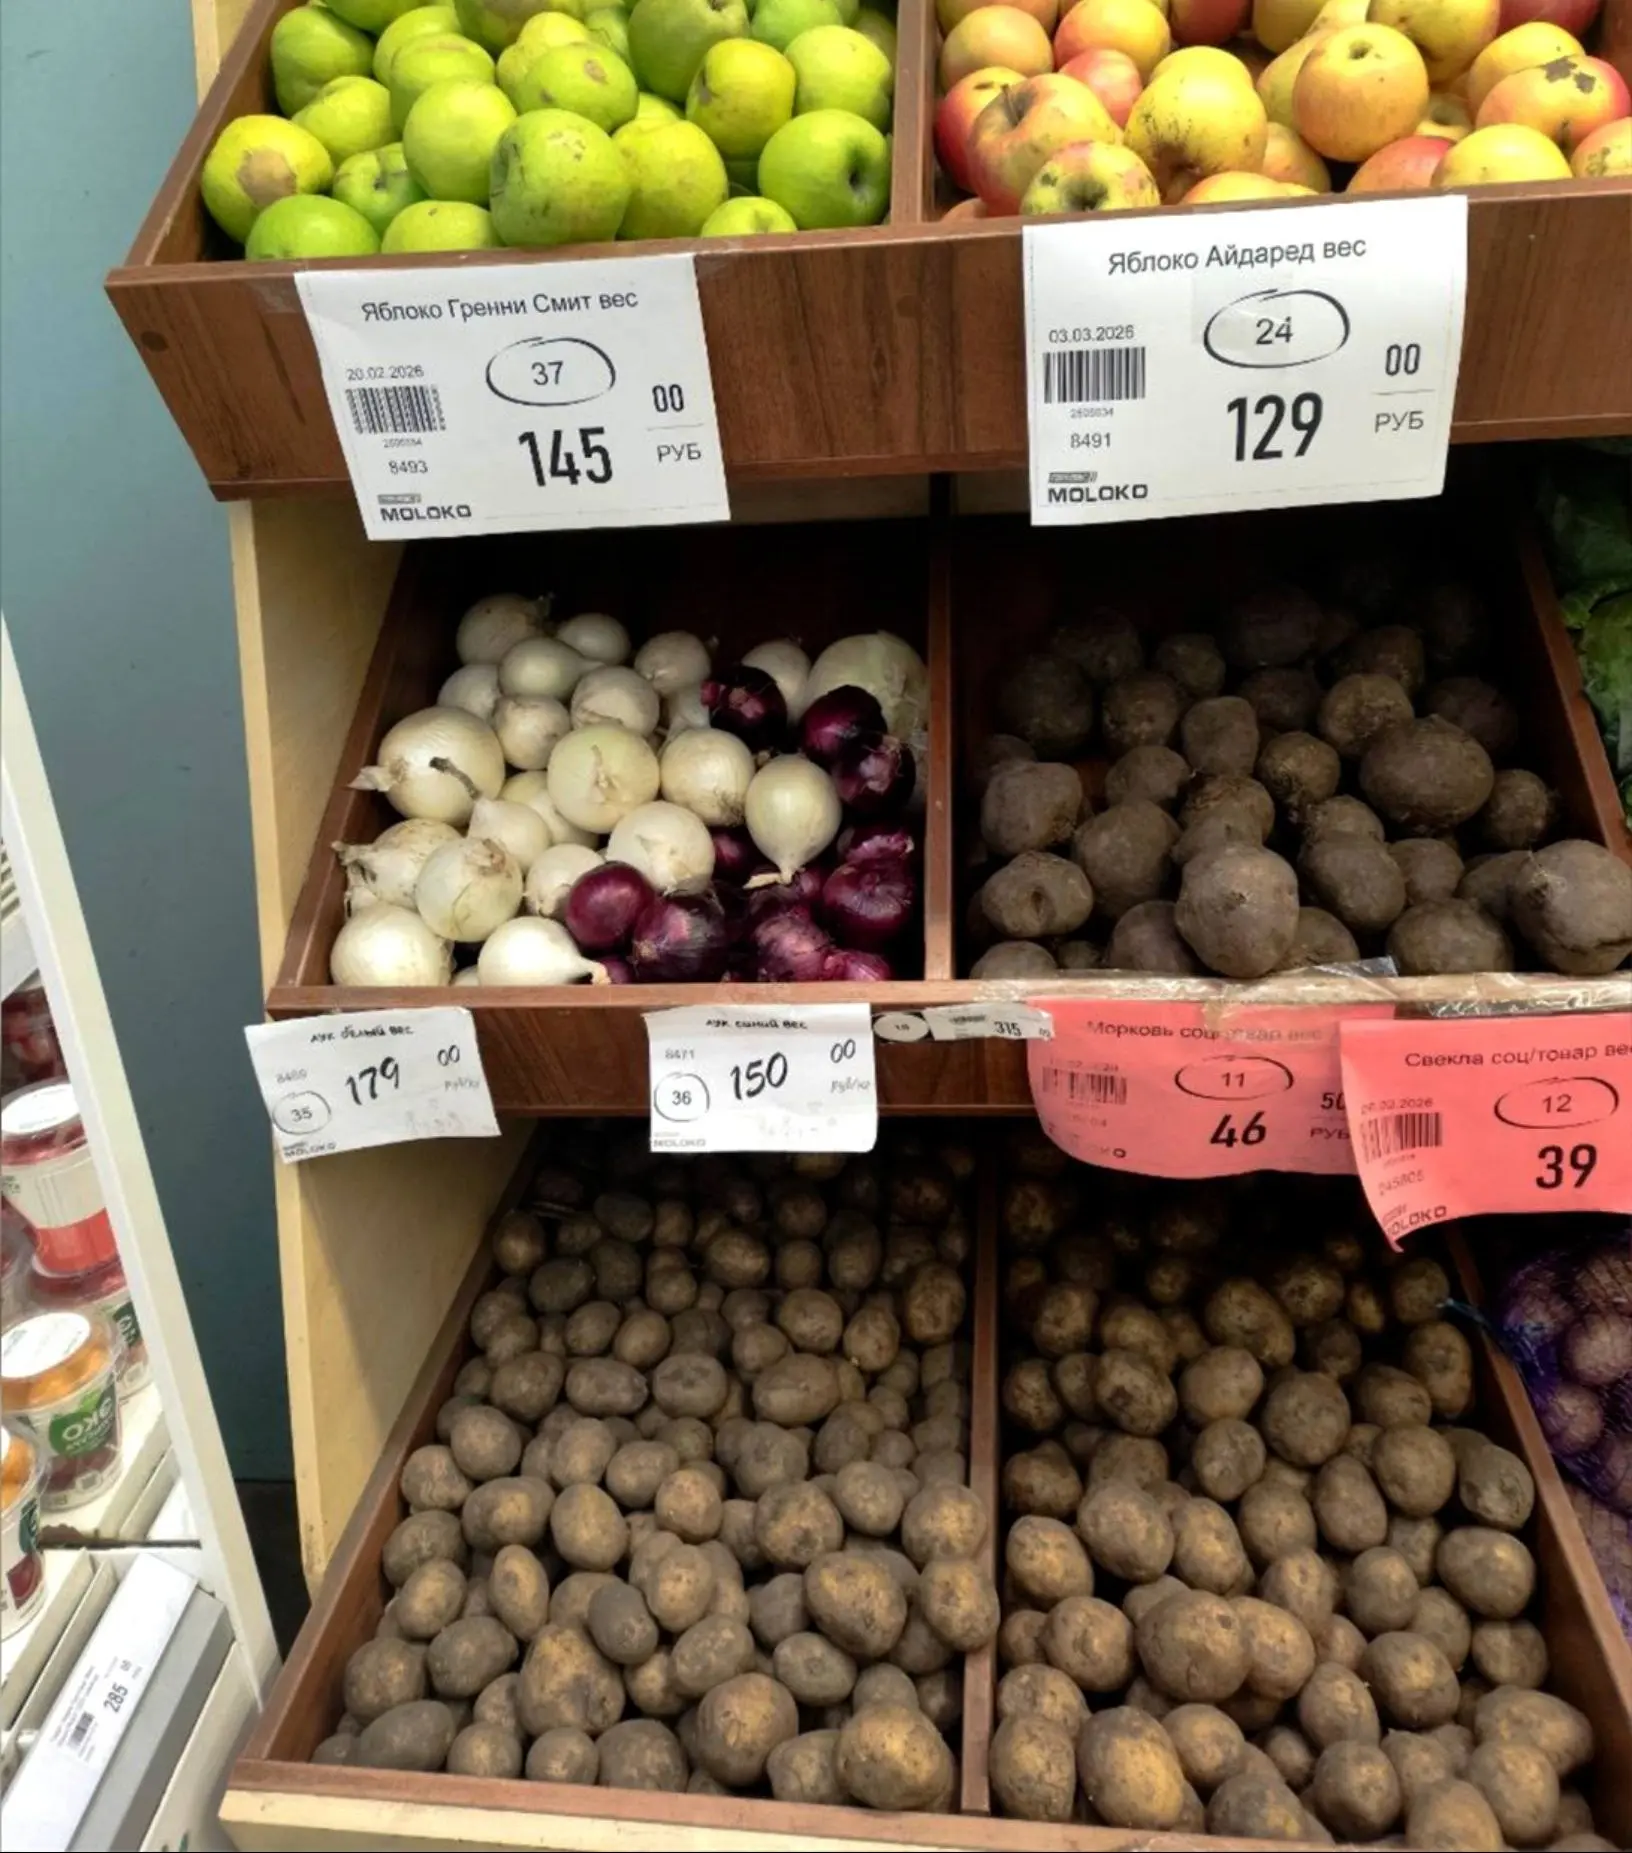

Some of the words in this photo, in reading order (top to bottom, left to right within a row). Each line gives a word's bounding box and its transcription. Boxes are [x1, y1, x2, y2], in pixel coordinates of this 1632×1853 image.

[1108, 251, 1199, 276] Яблоко
[1205, 242, 1316, 270] Айдаред
[1322, 238, 1367, 259] вес
[361, 301, 443, 322] Яблоко
[448, 298, 527, 322] Гренни
[533, 294, 591, 314] Смит
[598, 291, 639, 309] вес
[1048, 325, 1135, 344] 03.03.2026
[1255, 316, 1294, 345] 24
[347, 364, 425, 381] 20.02.2026
[1385, 344, 1421, 377] 00
[531, 361, 564, 386] 37
[652, 384, 685, 413] 00
[1227, 391, 1324, 462] 129
[1374, 410, 1425, 433] РУБ
[656, 443, 702, 462] РУБ
[1070, 432, 1111, 449] 8491
[388, 460, 429, 475] 8493
[518, 427, 613, 487] 145
[1048, 484, 1148, 503] MOLOKO
[380, 505, 472, 521] MOLOKO
[1180, 1023, 1282, 1042] соцвар
[437, 1044, 461, 1067] 00
[830, 1039, 856, 1063] 00
[1405, 1052, 1484, 1067] Свекла
[1491, 1045, 1598, 1065] соц/товар
[1605, 1043, 1632, 1057] ве
[345, 1056, 400, 1106] 179
[730, 1052, 788, 1100] 150
[1221, 1071, 1246, 1089] 11
[672, 1090, 692, 1105] 36
[1542, 1094, 1573, 1114] 12
[291, 1107, 313, 1122] 35
[1209, 1110, 1268, 1148] 46
[1535, 1144, 1598, 1189] 39
[103, 1682, 128, 1713] 285
